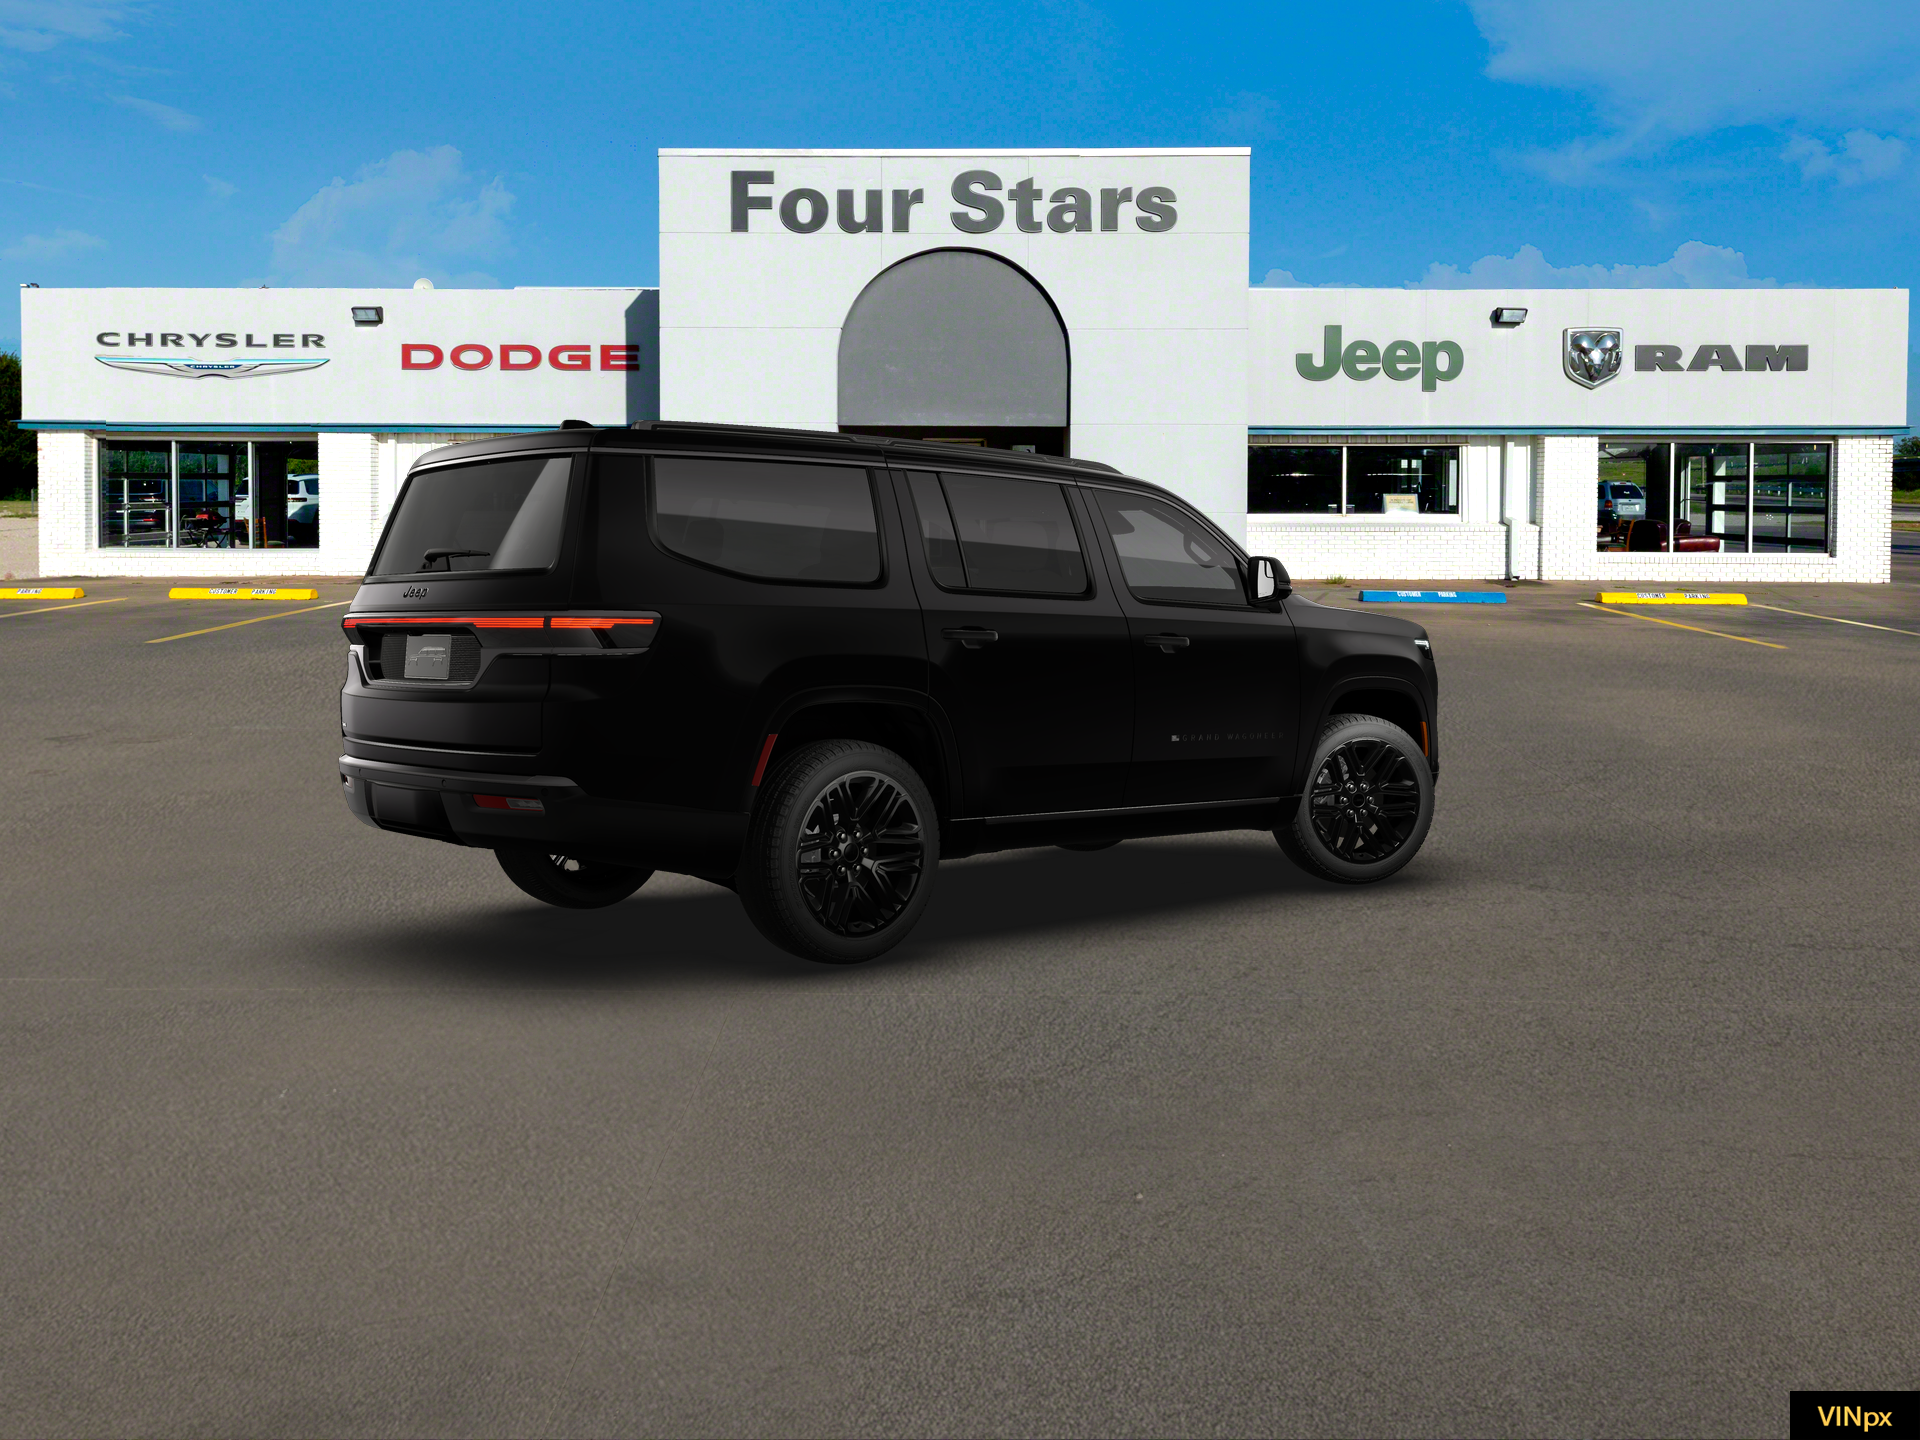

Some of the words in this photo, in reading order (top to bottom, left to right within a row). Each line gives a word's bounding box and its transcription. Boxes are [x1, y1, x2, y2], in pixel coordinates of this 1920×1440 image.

[730, 169, 925, 234] Four
[949, 168, 1179, 235] Stars
[96, 331, 327, 349] CHRYSLER
[400, 342, 641, 373] DODGE
[1295, 323, 1465, 392] Jeep
[1634, 343, 1810, 373] RAM
[402, 585, 430, 600] Jeep
[1396, 590, 1423, 598] CUSTOMER
[1181, 733, 1221, 742] GRAND
[1226, 731, 1285, 741] WAGONEER
